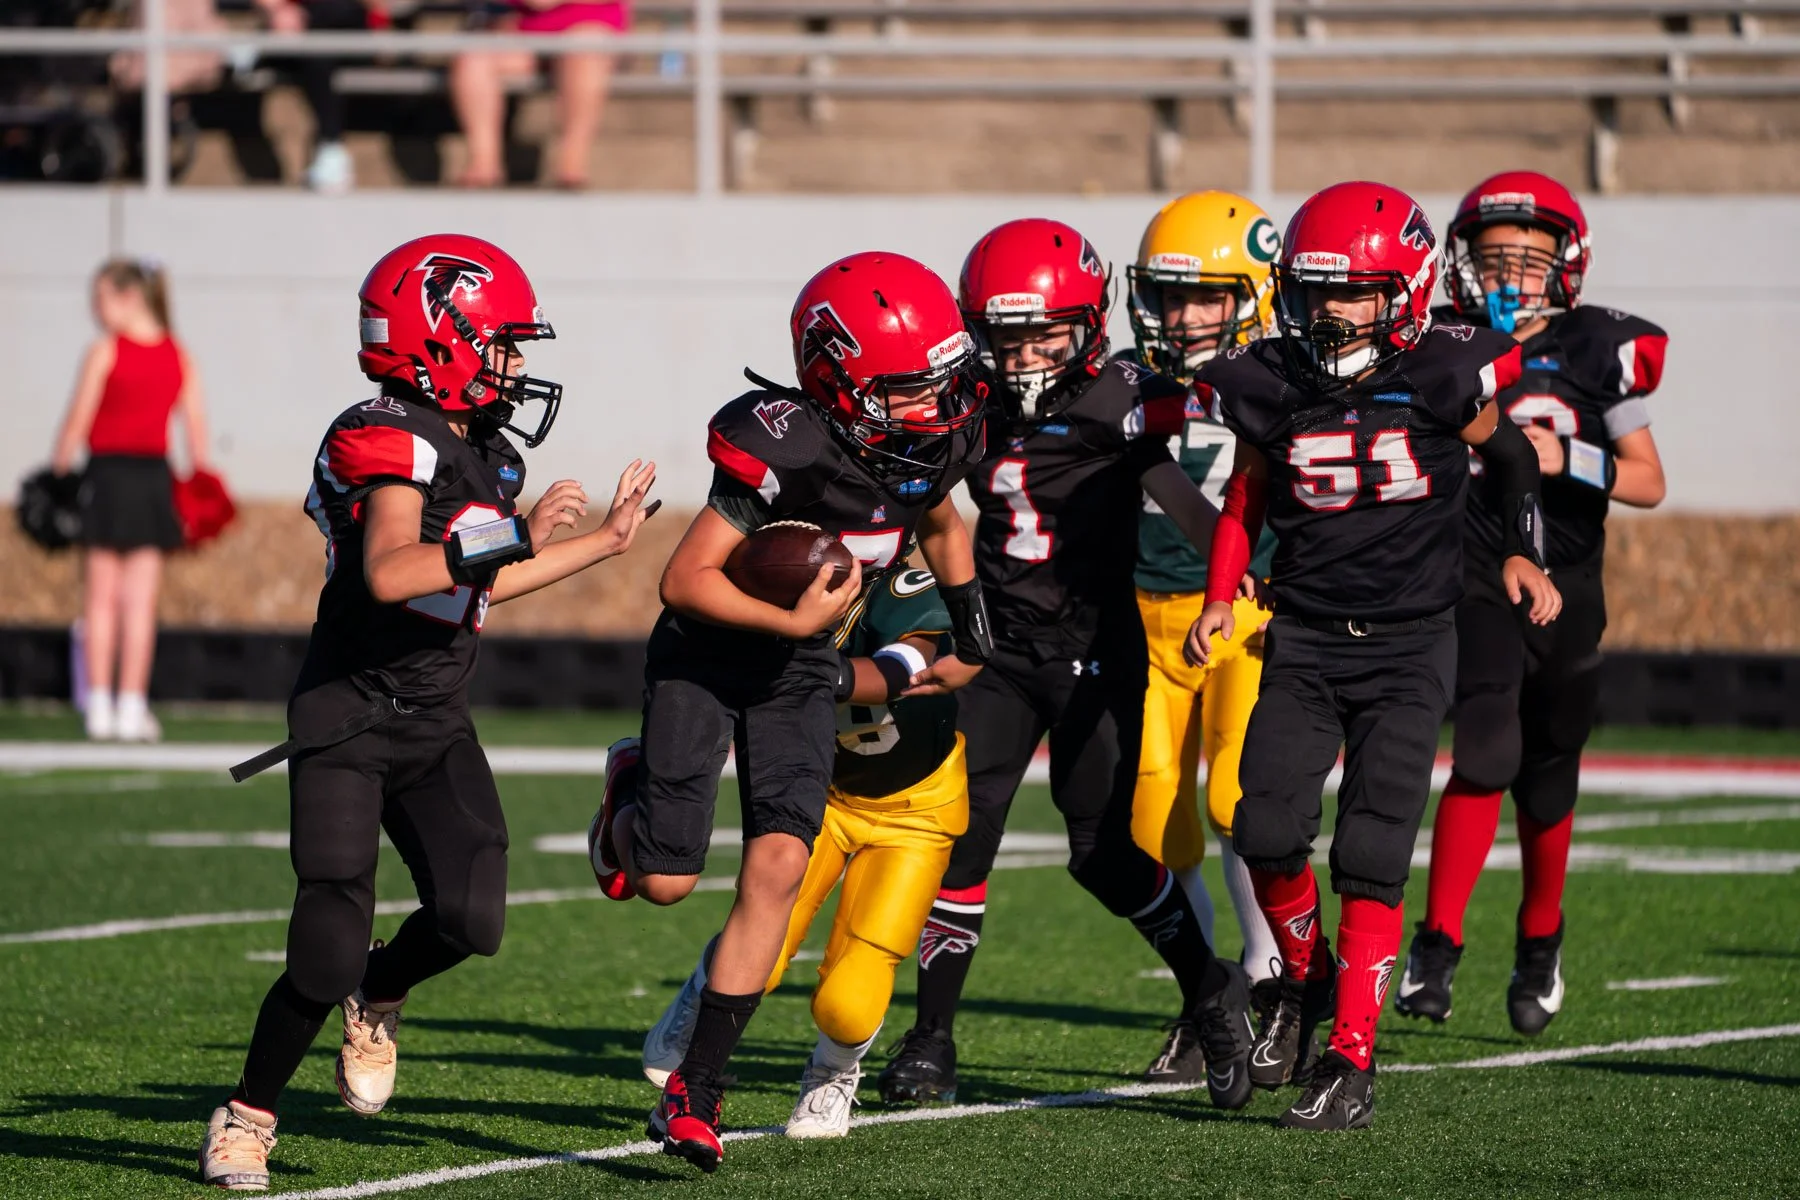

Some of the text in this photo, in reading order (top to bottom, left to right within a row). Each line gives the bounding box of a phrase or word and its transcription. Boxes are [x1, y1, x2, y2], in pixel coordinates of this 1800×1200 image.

[1247, 217, 1282, 262] G
[1307, 255, 1337, 265] Riddell
[1000, 297, 1032, 307] Riddell
[1287, 428, 1432, 511] 51
[990, 456, 1053, 563] 1
[894, 568, 936, 595] G
